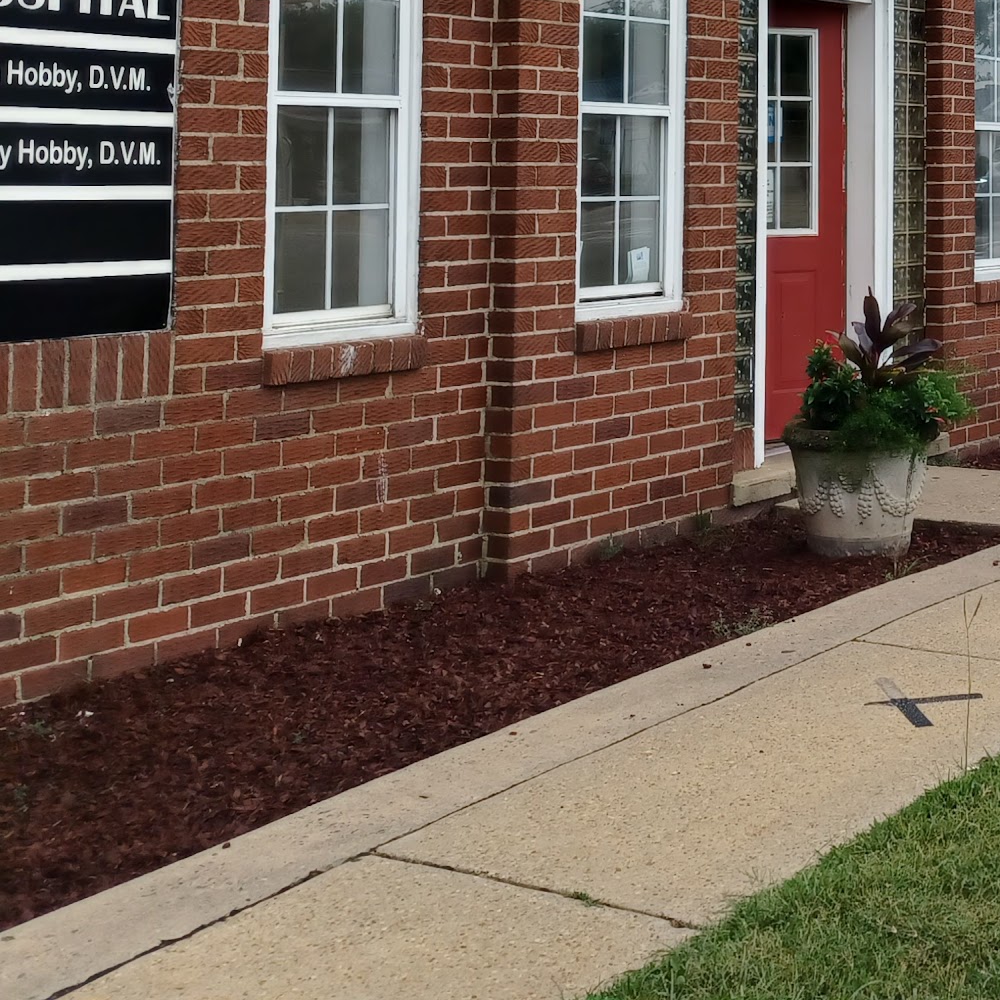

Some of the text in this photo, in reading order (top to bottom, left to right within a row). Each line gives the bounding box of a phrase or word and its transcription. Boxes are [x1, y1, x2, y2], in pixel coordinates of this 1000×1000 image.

[7, 59, 151, 94] Hobby, D.V.M.
[18, 138, 93, 171] Hobby,
[100, 141, 161, 165] D.V.M.
